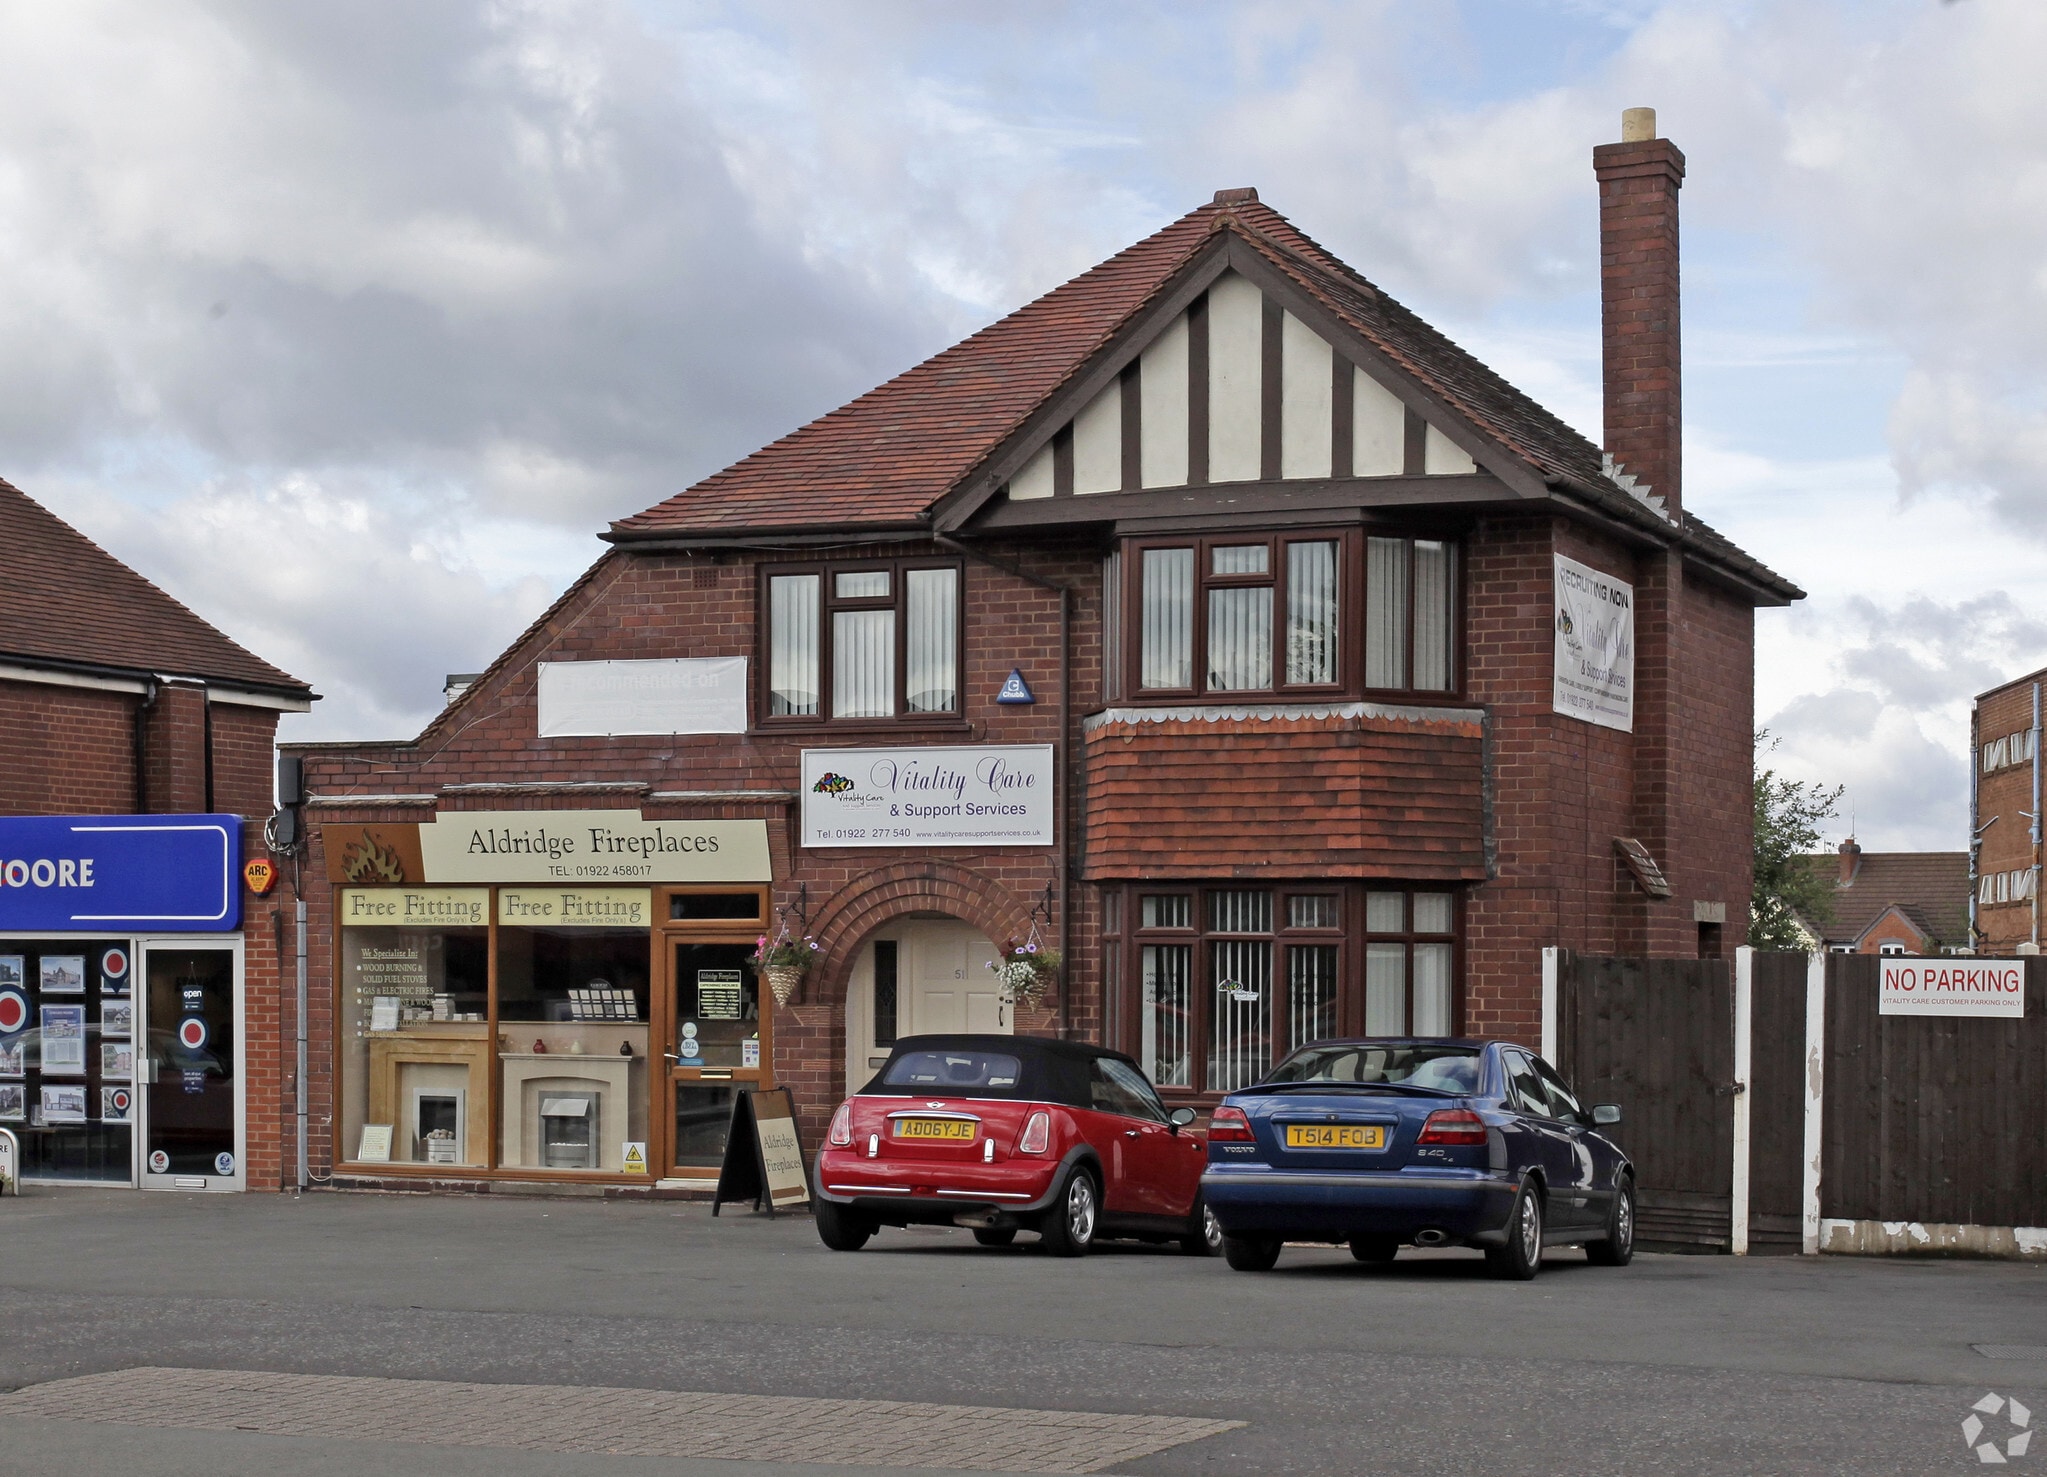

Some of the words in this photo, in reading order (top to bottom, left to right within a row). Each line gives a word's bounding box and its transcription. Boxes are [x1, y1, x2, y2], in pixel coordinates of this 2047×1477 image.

[1560, 567, 1607, 600] RECRUITING
[870, 758, 967, 800] Vitality
[976, 756, 1036, 798] Care
[837, 792, 864, 805] Vitality
[865, 793, 885, 802] Care
[890, 804, 900, 817] &
[904, 803, 961, 819] Support
[965, 803, 1027, 816] Services
[817, 829, 834, 838] Tel.
[836, 829, 866, 838] 01922
[872, 828, 890, 838] 277
[893, 828, 911, 838] 540
[467, 828, 575, 859] Aldridge
[588, 827, 719, 859] Fireplaces
[0, 858, 95, 888] OORE
[248, 865, 268, 876] ARC
[549, 866, 573, 876] TEL:
[576, 866, 609, 876] 01922
[612, 866, 652, 876] 458017
[351, 895, 396, 915] Free
[404, 895, 482, 922] Fitting
[505, 895, 552, 915] Free
[560, 895, 642, 923] Fitting
[361, 948, 372, 957] We
[373, 948, 406, 960] Specialize
[362, 963, 385, 972] WOOD
[386, 963, 417, 972] BURNING
[362, 975, 383, 984] SOLID
[384, 975, 401, 984] FUEL
[402, 975, 428, 984] STOVES
[1885, 968, 1917, 991] NO
[1923, 969, 2019, 993] PARKING
[183, 990, 202, 999] open
[362, 986, 376, 995] GAS
[382, 986, 414, 995] ELECTRIC
[415, 986, 434, 995] FIRES
[764, 1133, 794, 1149] Aldridge
[1293, 1128, 1333, 1144] T514
[1339, 1129, 1377, 1145] FOB
[765, 1157, 802, 1173] Fireplaces
